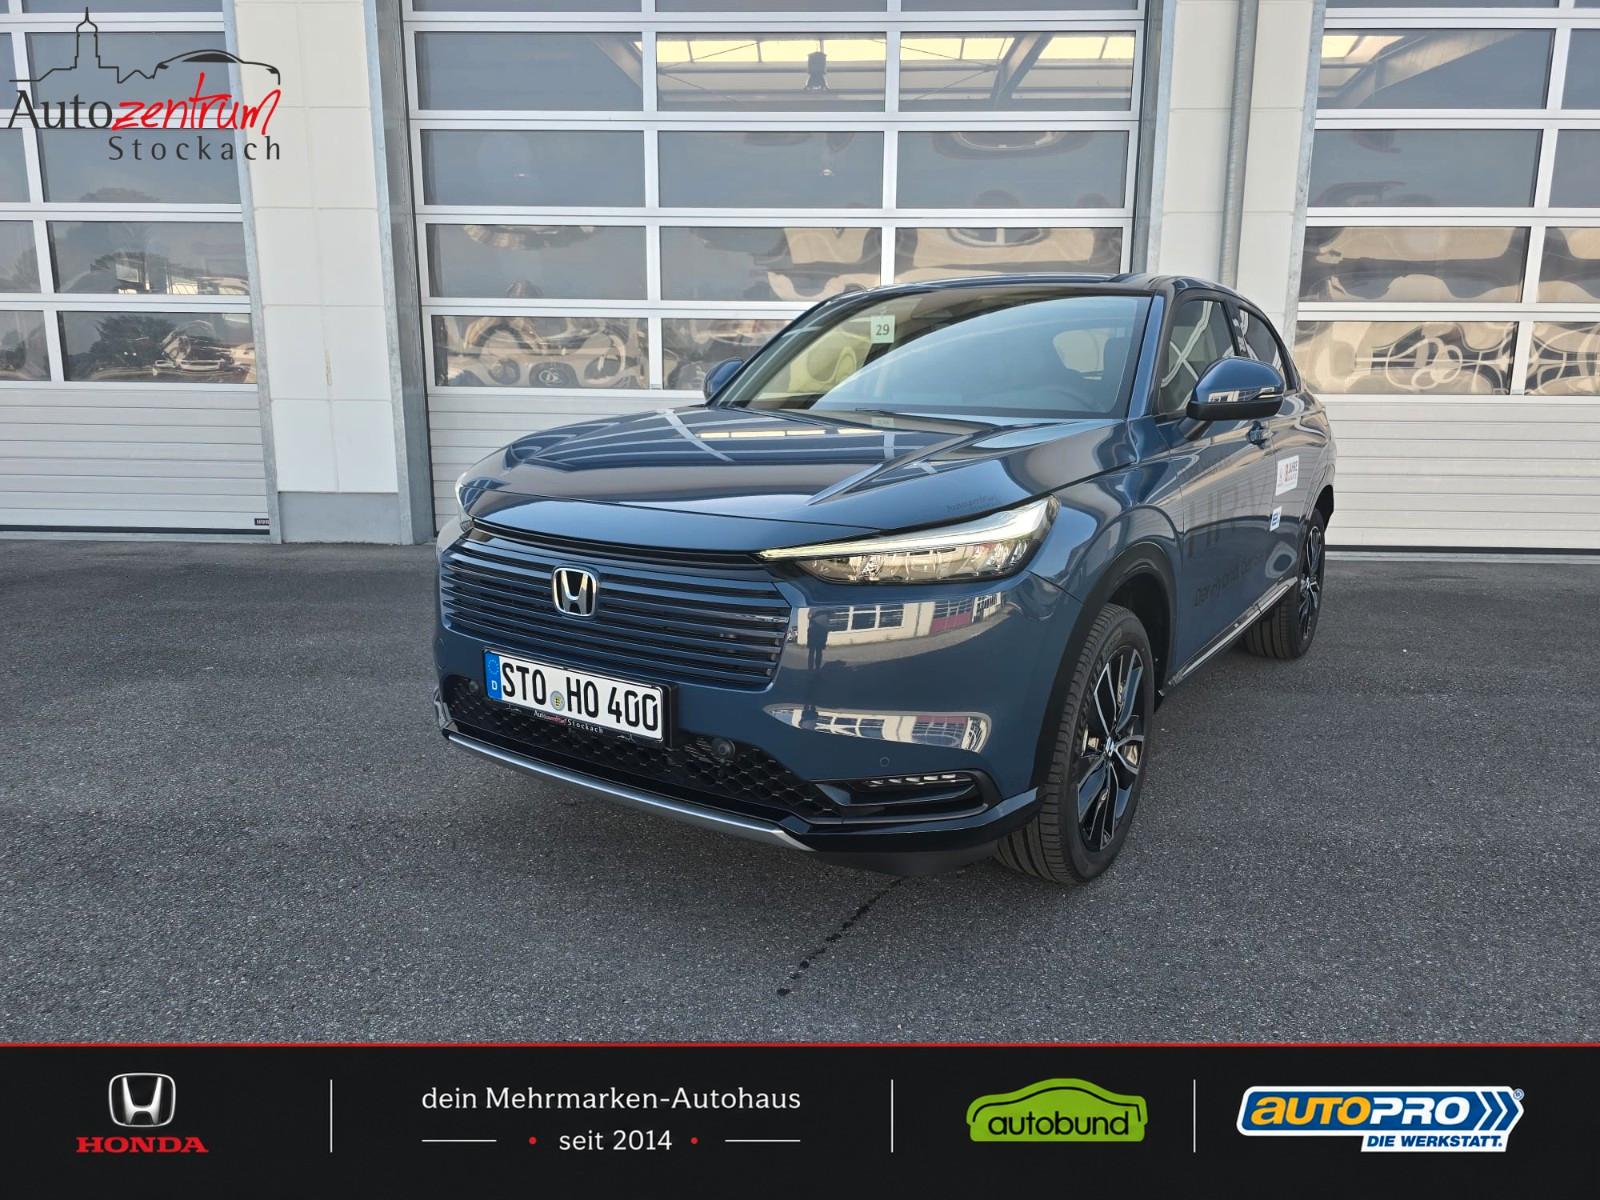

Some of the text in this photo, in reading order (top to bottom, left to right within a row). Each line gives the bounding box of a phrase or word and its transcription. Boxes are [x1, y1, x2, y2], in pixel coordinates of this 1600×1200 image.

[876, 324, 890, 336] 29
[501, 662, 659, 732] STO HO 400
